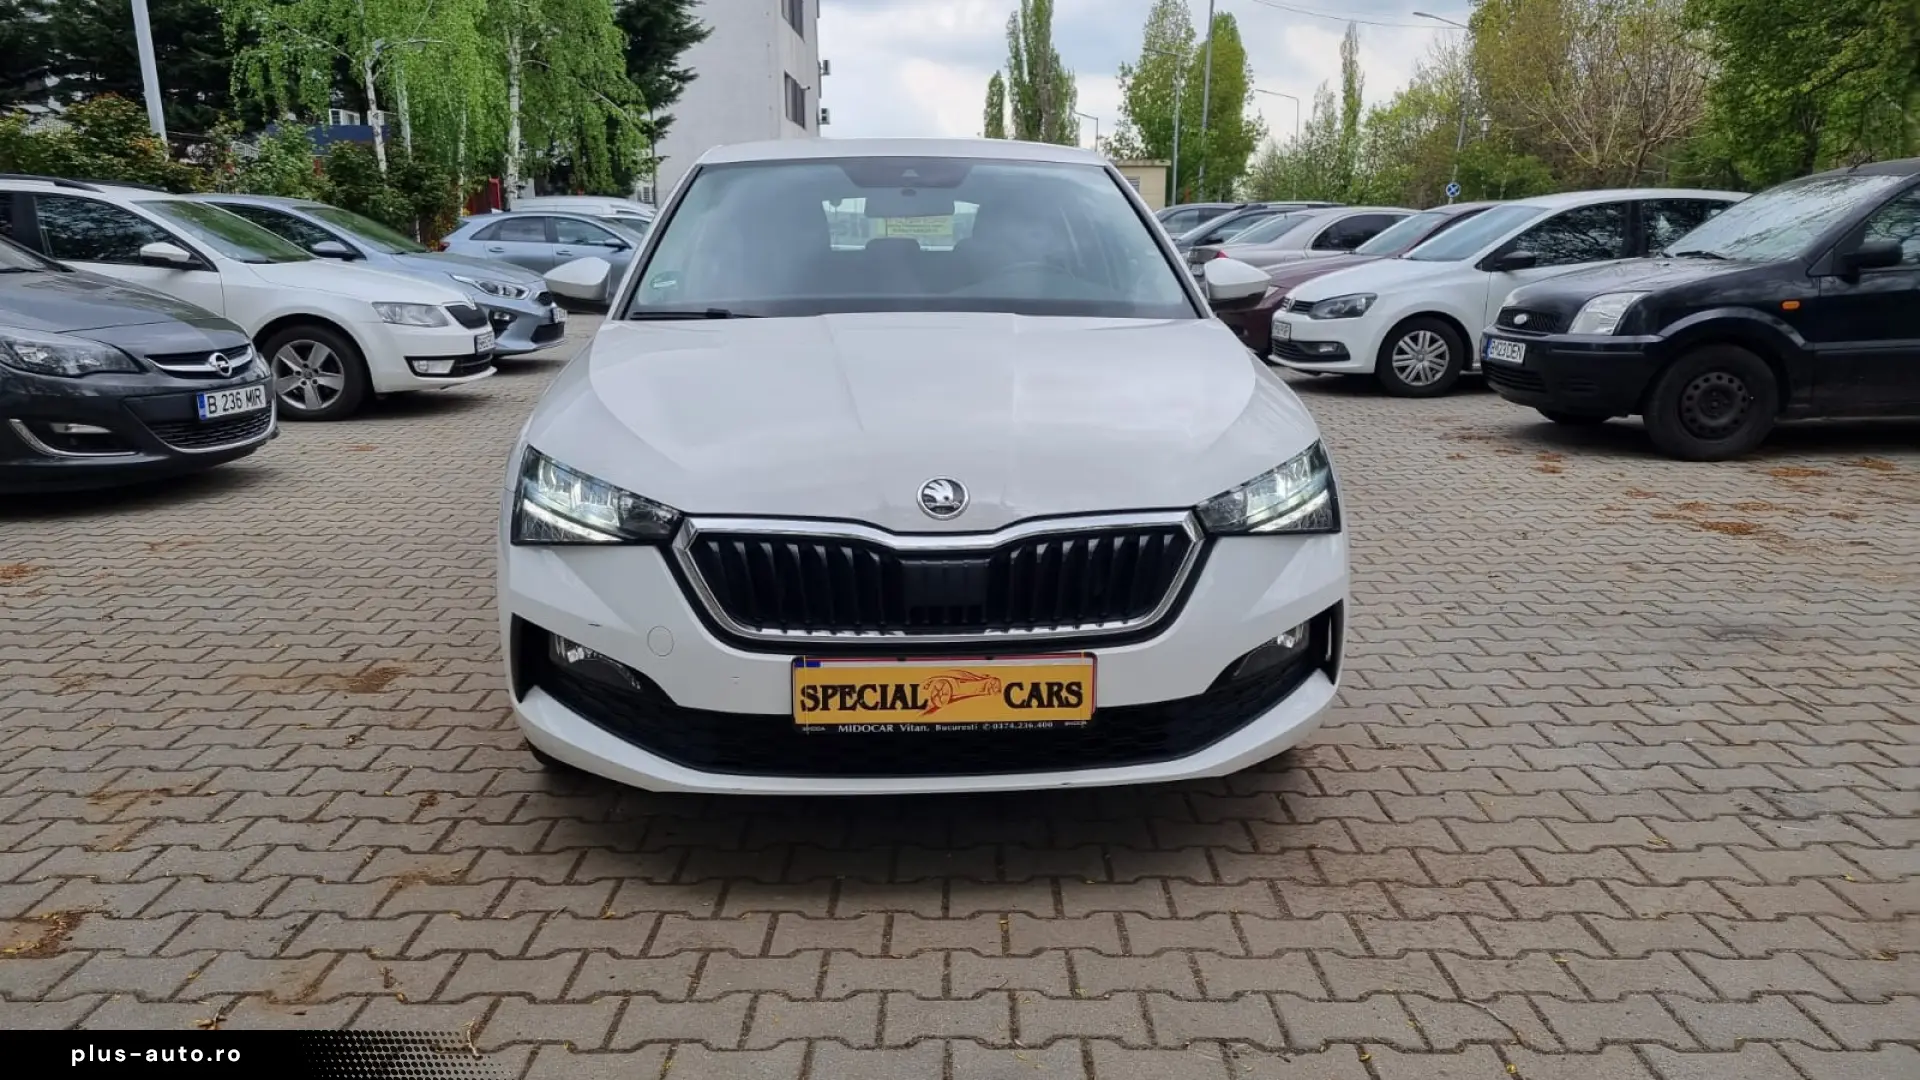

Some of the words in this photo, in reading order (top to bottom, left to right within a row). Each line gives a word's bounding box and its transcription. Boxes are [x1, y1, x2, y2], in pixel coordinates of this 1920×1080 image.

[207, 396, 218, 414] B
[221, 391, 243, 412] 236
[245, 388, 264, 408] MIR
[800, 684, 928, 712] SPECIAL
[1004, 681, 1083, 708] CARS
[838, 724, 894, 733] MIDOCAR
